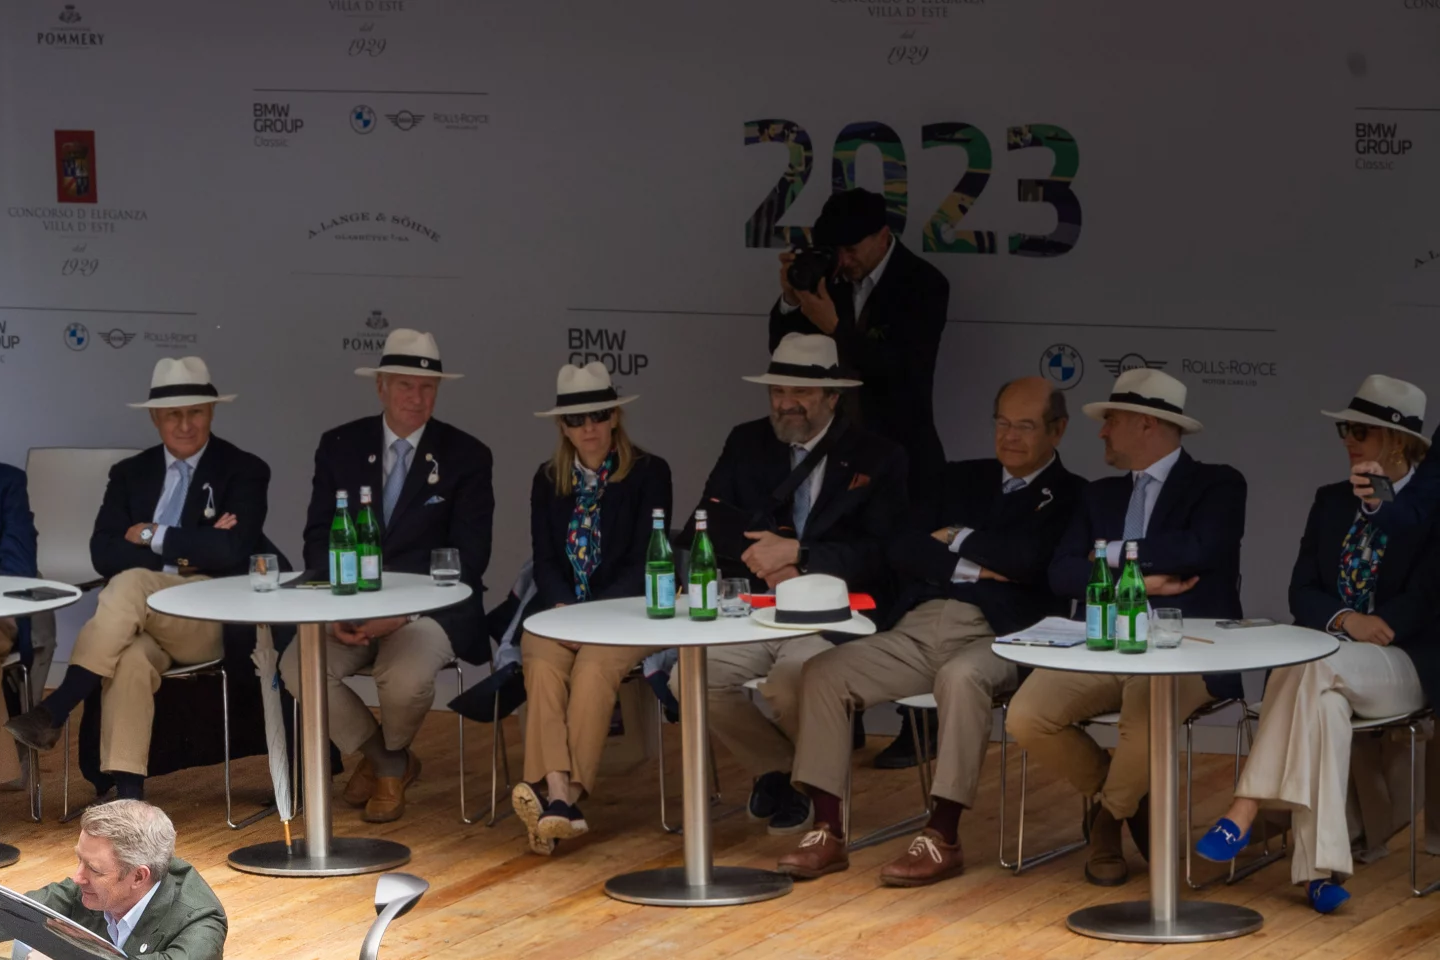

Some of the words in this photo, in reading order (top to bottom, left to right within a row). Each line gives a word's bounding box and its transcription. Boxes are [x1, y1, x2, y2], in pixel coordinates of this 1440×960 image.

[868, 6, 901, 18] VILLA
[37, 32, 104, 45] POMMERY
[348, 38, 387, 57] 1929
[887, 45, 929, 65] 1929
[253, 103, 290, 118] BMW
[253, 119, 304, 133] GROUP
[1355, 122, 1397, 138] BMW
[253, 135, 289, 147] Classic
[1355, 139, 1412, 155] GROUP
[1355, 157, 1395, 170] Classic
[744, 119, 1082, 258] 2023
[8, 207, 74, 219] CONCORSO
[42, 220, 74, 232] VILLA
[320, 212, 371, 231] LANGE
[375, 212, 386, 222] &
[392, 215, 441, 243] SÖHNE
[61, 258, 99, 277] 1929
[568, 328, 626, 351] BMW
[1182, 359, 1277, 377] ROLLS-ROYCE
